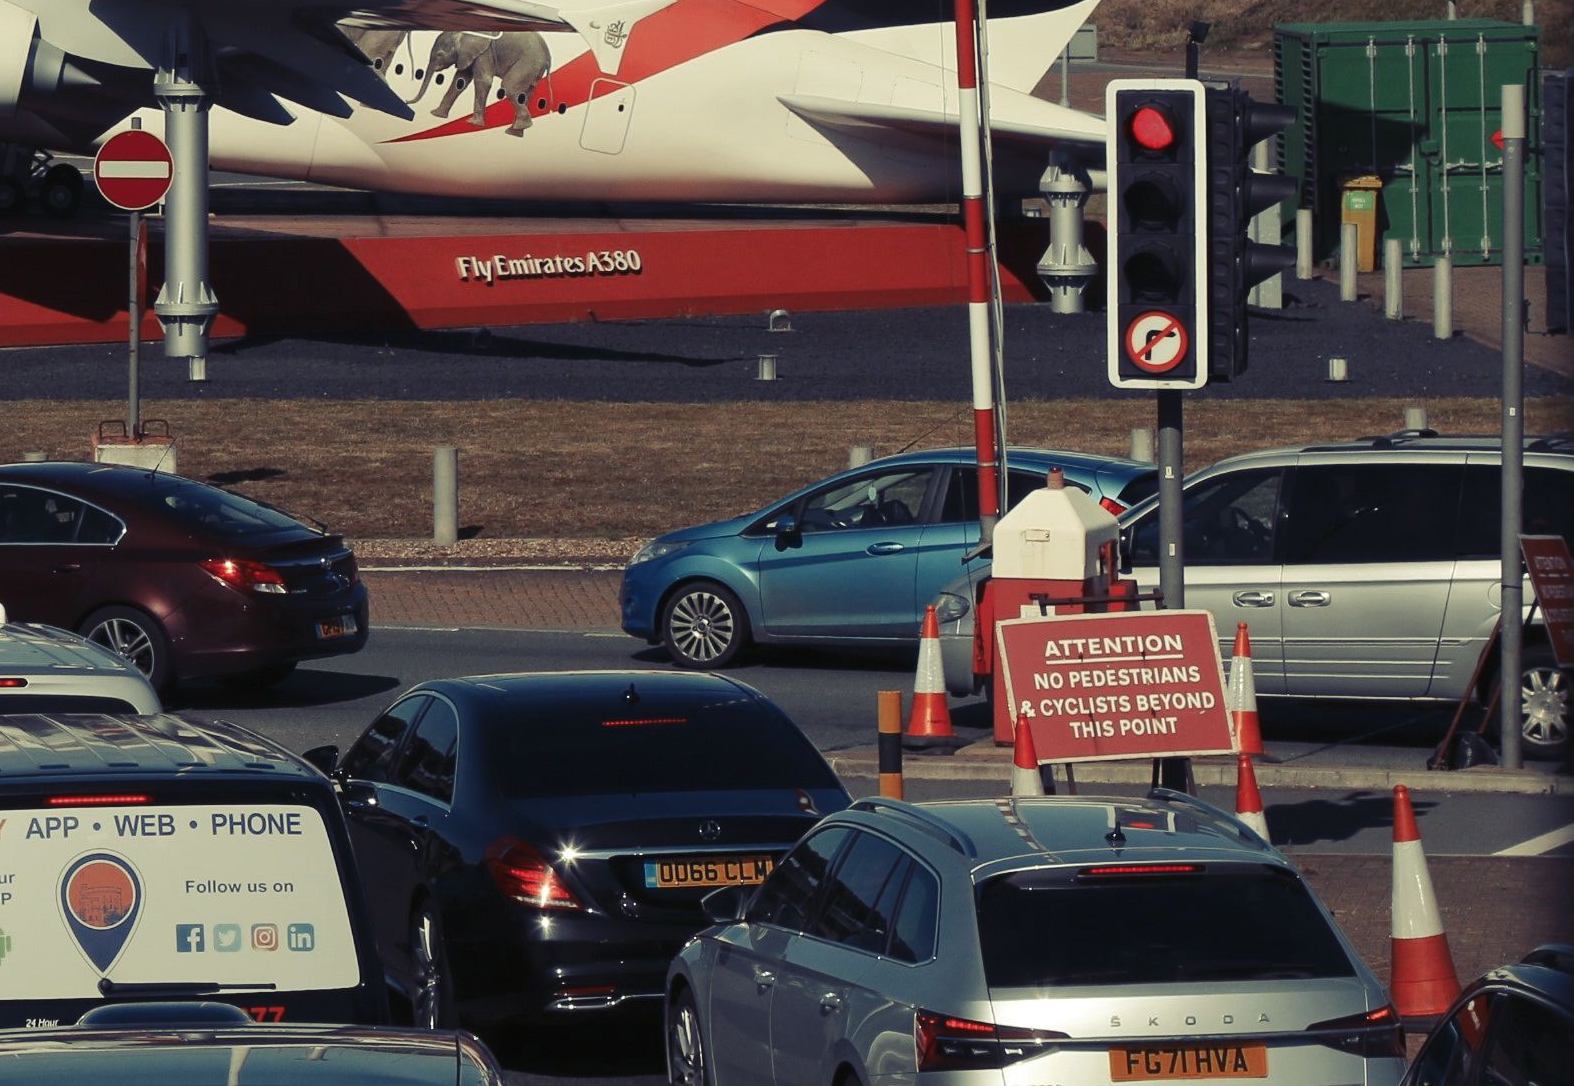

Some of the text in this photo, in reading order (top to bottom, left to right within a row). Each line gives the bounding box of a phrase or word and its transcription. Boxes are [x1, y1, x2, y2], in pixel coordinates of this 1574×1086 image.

[457, 249, 642, 283] Fly Emirates A380
[1044, 634, 1183, 657] ATTENTION
[1034, 665, 1201, 690] NO PEDESTRIANS
[1021, 691, 1215, 717] & CYCLISTS BEYOND
[1069, 717, 1178, 738] THIS POINT
[26, 816, 79, 839] APP
[114, 814, 176, 837] WEB
[211, 813, 302, 836] PHONE
[186, 880, 294, 894] Follow us on
[26, 1018, 36, 1028] 24
[241, 1007, 285, 1023] 77
[1127, 1046, 1248, 1074] FG71 HVA
